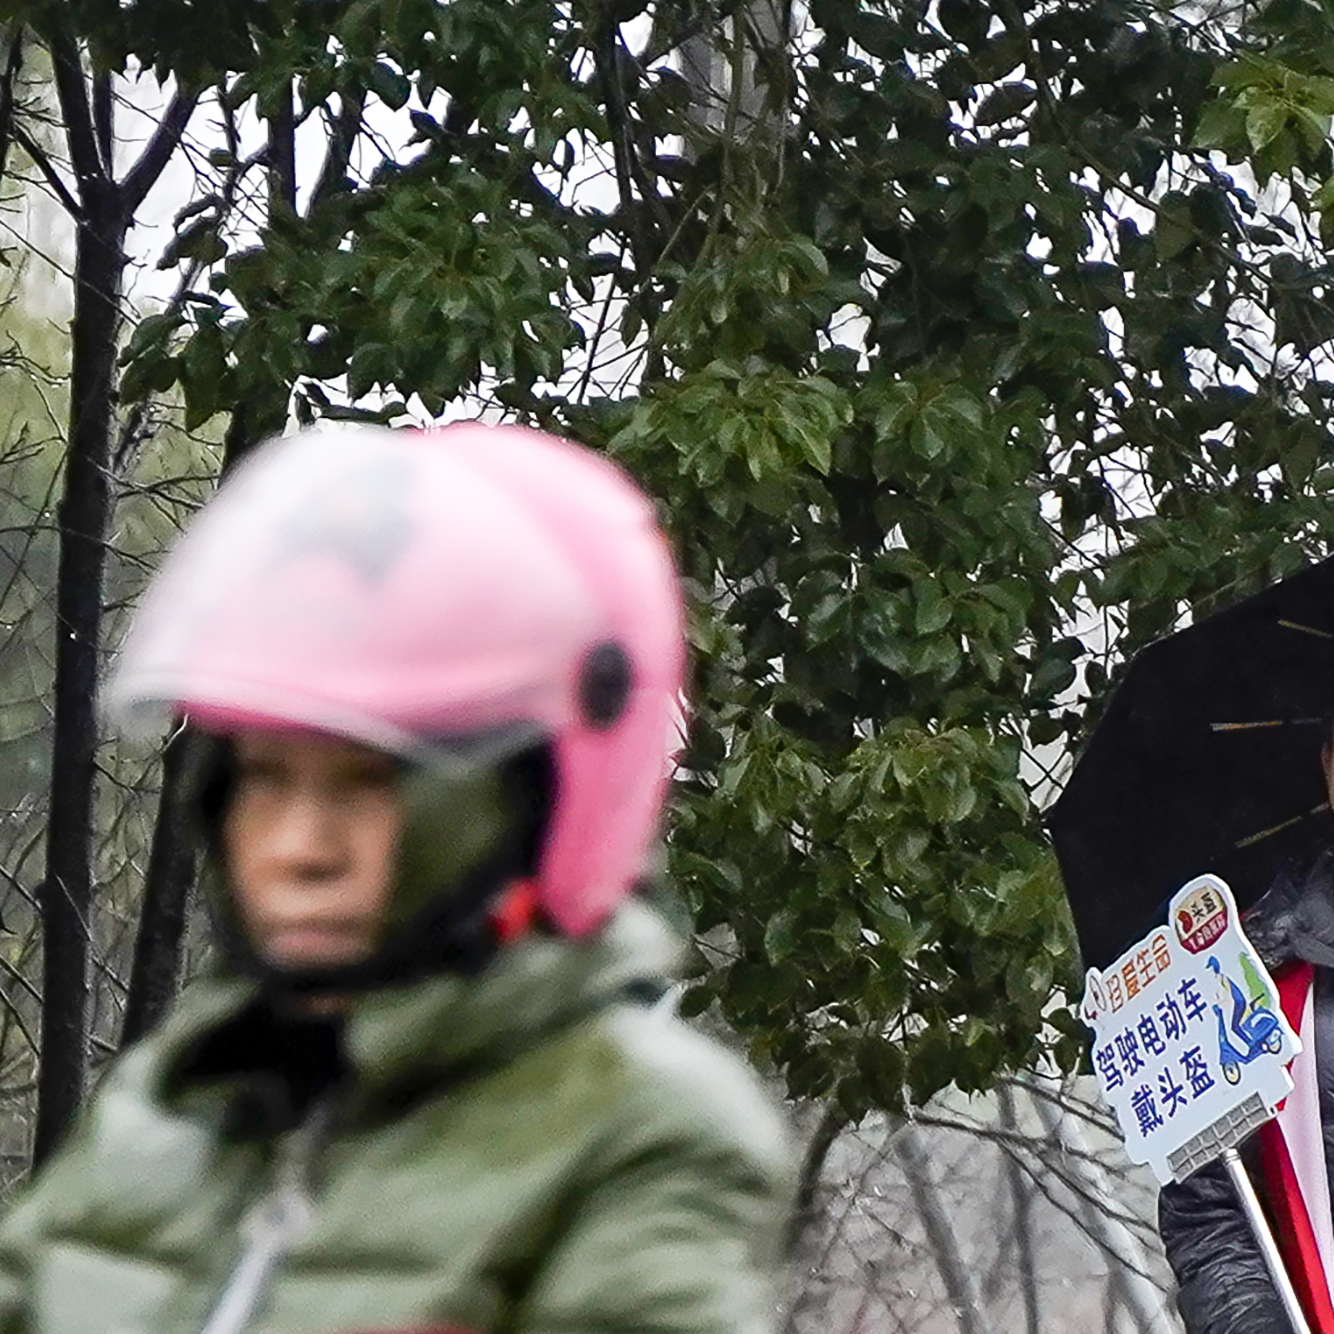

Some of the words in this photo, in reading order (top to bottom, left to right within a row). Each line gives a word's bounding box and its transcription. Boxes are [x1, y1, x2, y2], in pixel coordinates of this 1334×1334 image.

[1096, 977, 1208, 1093] 驾驶电动车
[1130, 1045, 1216, 1138] 戴头盔
